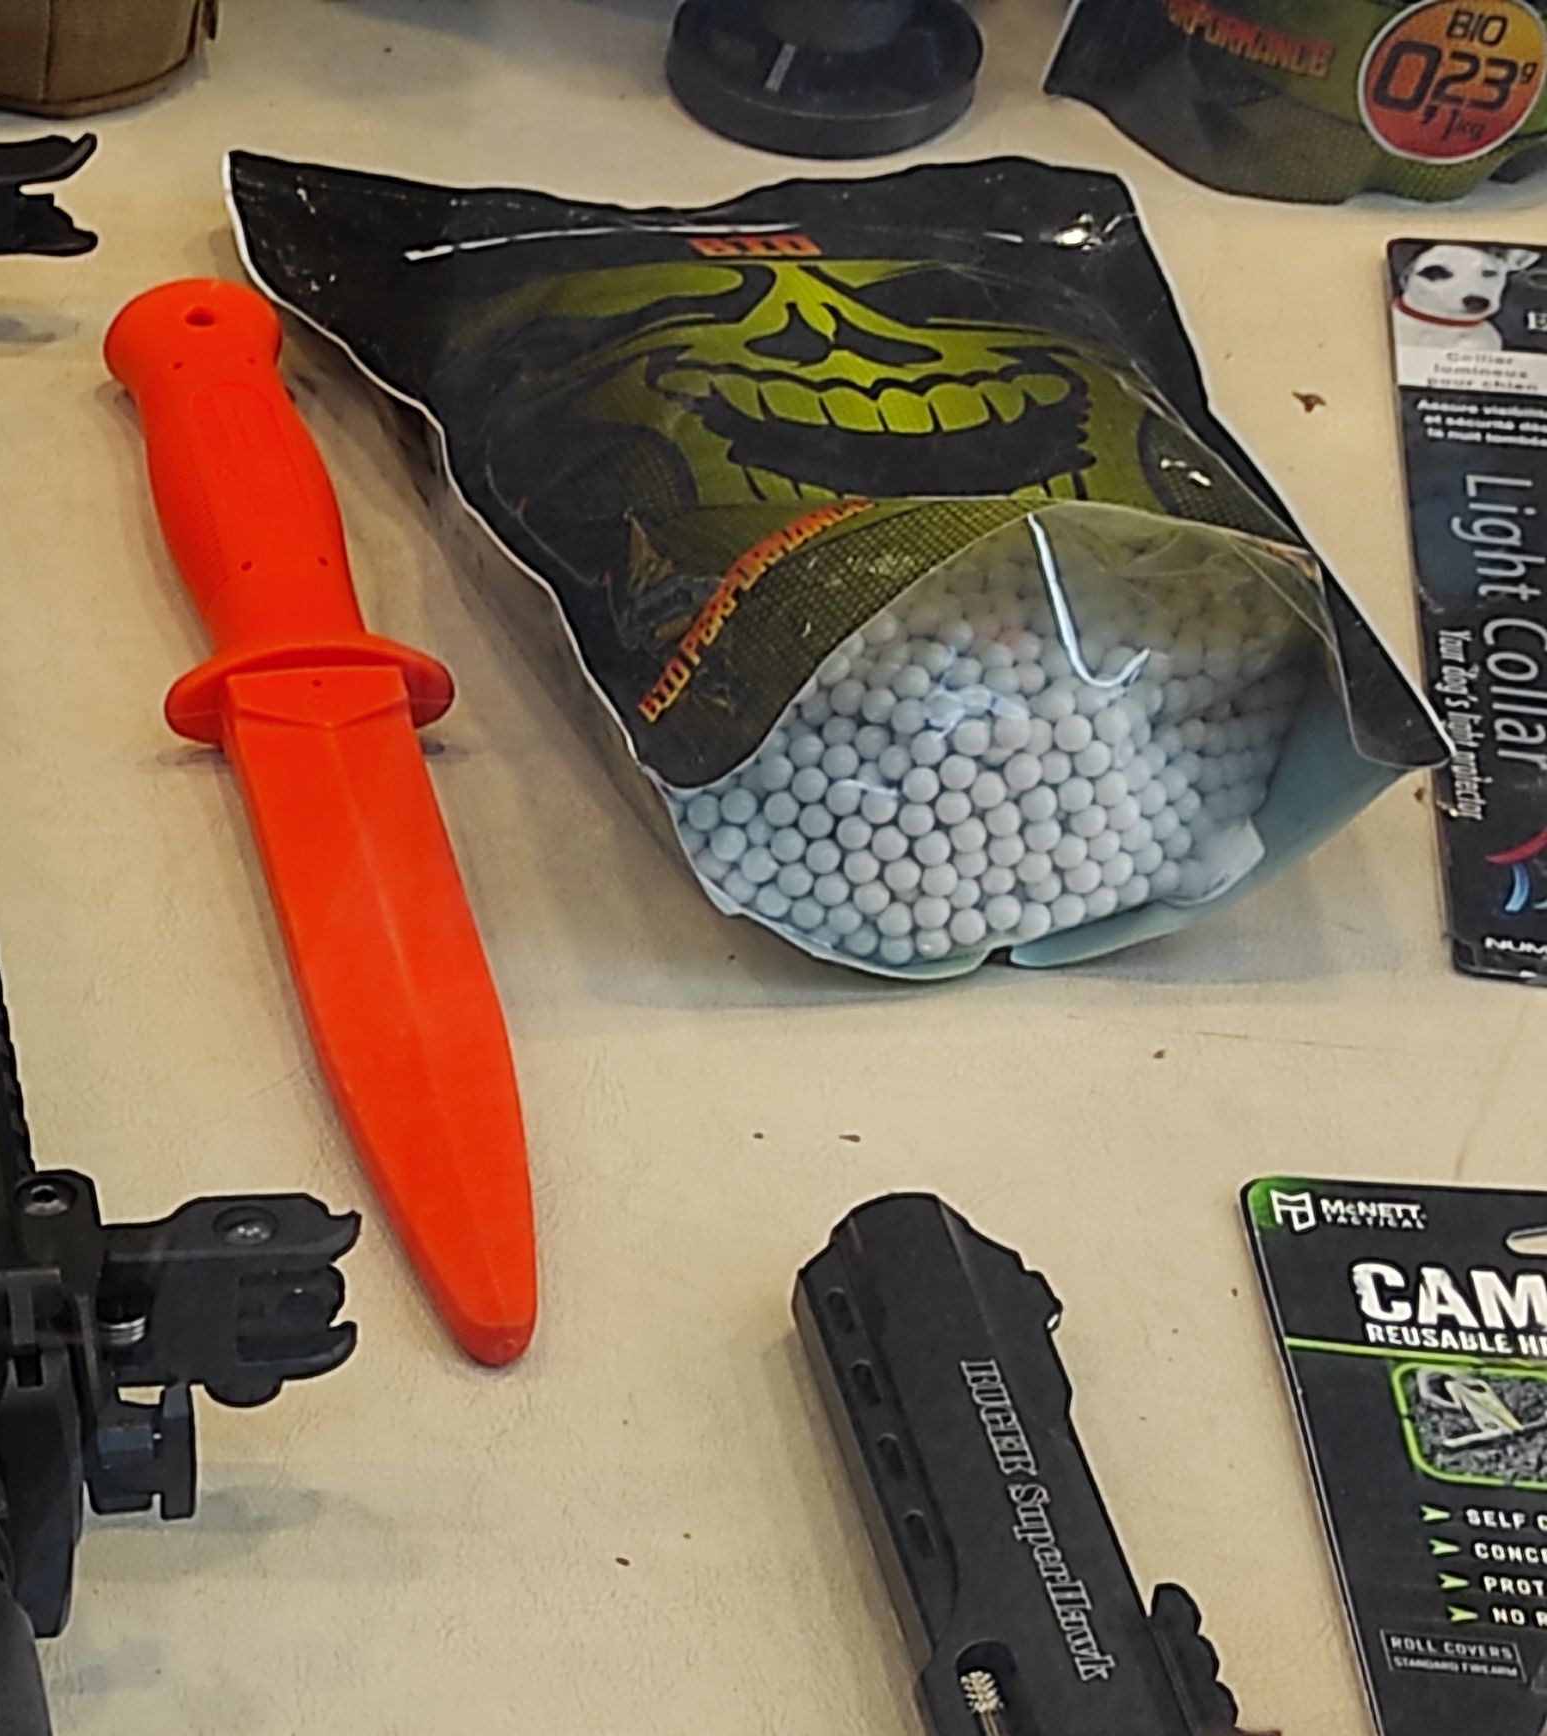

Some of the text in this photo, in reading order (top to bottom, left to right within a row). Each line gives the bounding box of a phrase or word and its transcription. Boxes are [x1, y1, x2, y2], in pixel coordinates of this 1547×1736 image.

[1447, 9, 1508, 47] BIO
[687, 234, 823, 257] BIO
[1451, 474, 1547, 773] Light Collar
[1439, 630, 1472, 663] Your
[639, 652, 691, 722] BIO
[1365, 1322, 1513, 1355] REUSABLE
[959, 1359, 1117, 1684] RUGER SuperHawk
[1466, 1508, 1526, 1530] SELF
[1492, 1607, 1525, 1626] NO
[1390, 1636, 1515, 1661] ROLL COVERS
